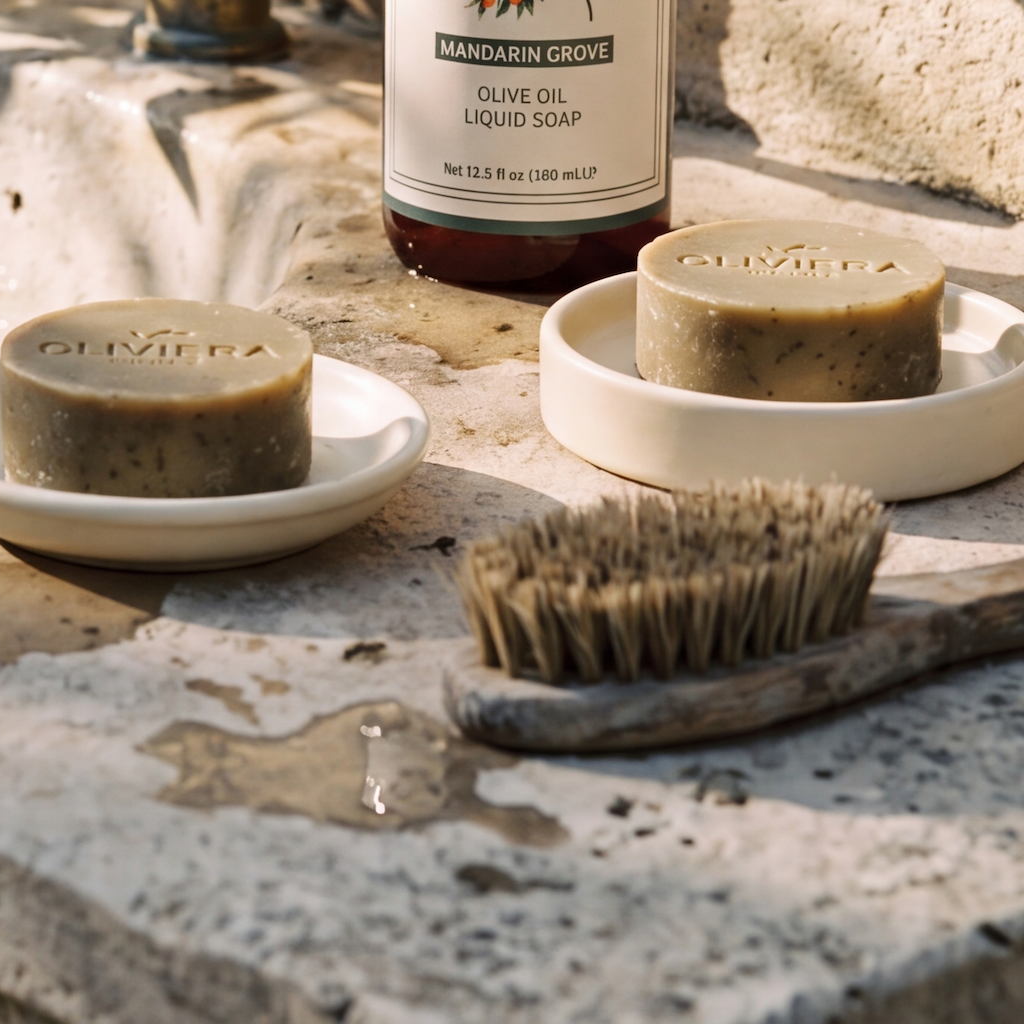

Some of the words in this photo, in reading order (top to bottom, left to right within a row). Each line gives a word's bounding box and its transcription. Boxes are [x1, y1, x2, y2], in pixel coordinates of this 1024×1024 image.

[440, 39, 542, 64] MANDARIN
[546, 41, 609, 63] GROVE
[477, 86, 531, 104] OLIVE
[537, 88, 568, 104] OIL
[465, 108, 526, 129] LIQUID
[532, 111, 582, 128] SOAP
[444, 162, 463, 177] Net
[466, 165, 492, 180] 12.5
[496, 168, 505, 180] fl
[509, 171, 524, 181] oz
[528, 169, 558, 183] (180
[676, 253, 911, 275] OLIVIERA
[38, 341, 281, 359] OLIVIERA
